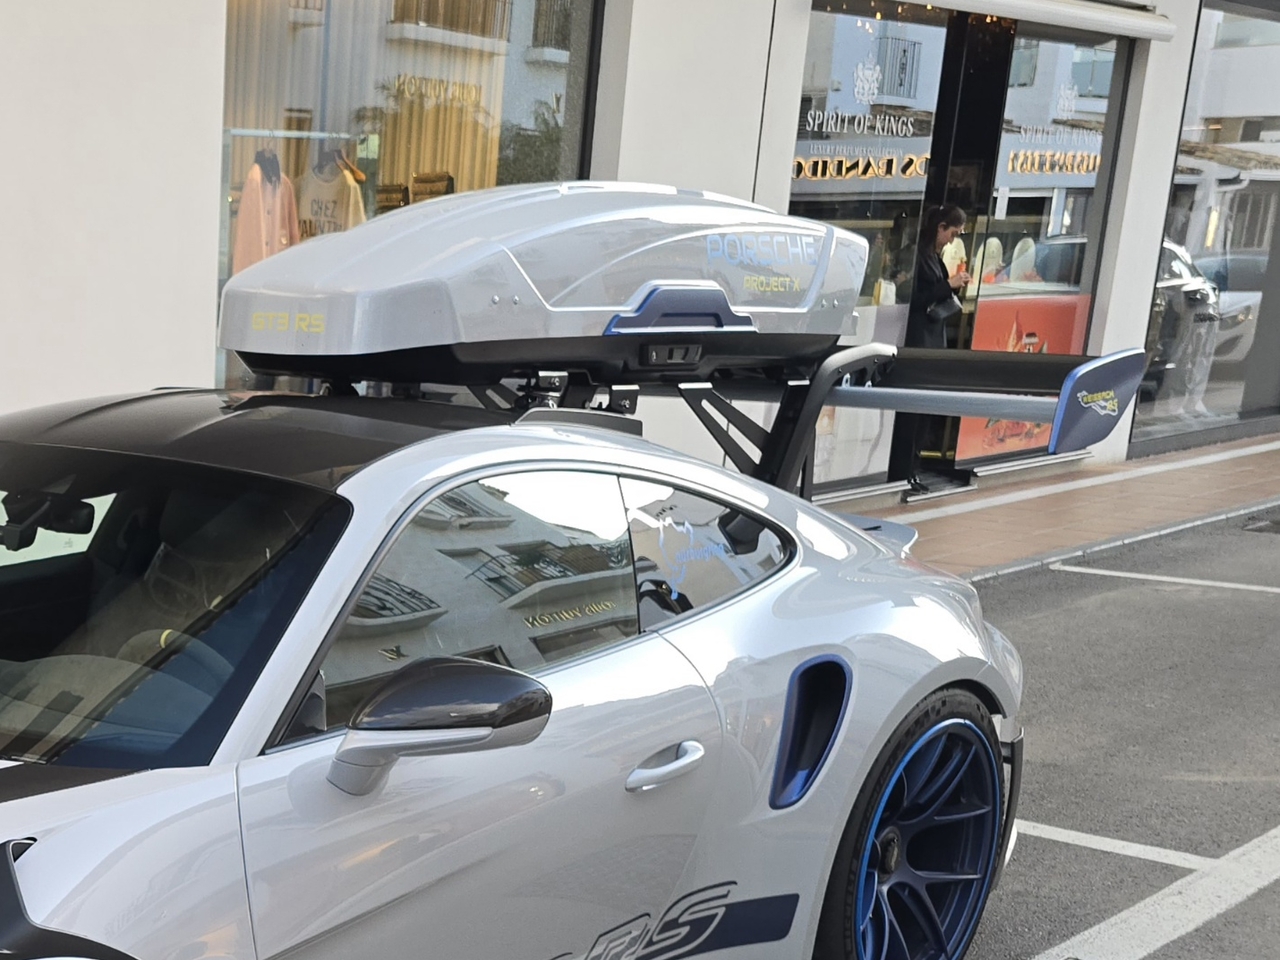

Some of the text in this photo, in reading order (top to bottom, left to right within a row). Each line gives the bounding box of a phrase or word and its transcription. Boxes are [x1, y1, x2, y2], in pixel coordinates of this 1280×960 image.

[805, 110, 914, 137] SPIRIT OF KINGS
[1019, 125, 1053, 144] SPIRIT
[1056, 127, 1068, 144] OF
[705, 232, 817, 266] PORSCHE
[743, 275, 800, 291] PROJECT X
[252, 312, 325, 334] GT3 RS
